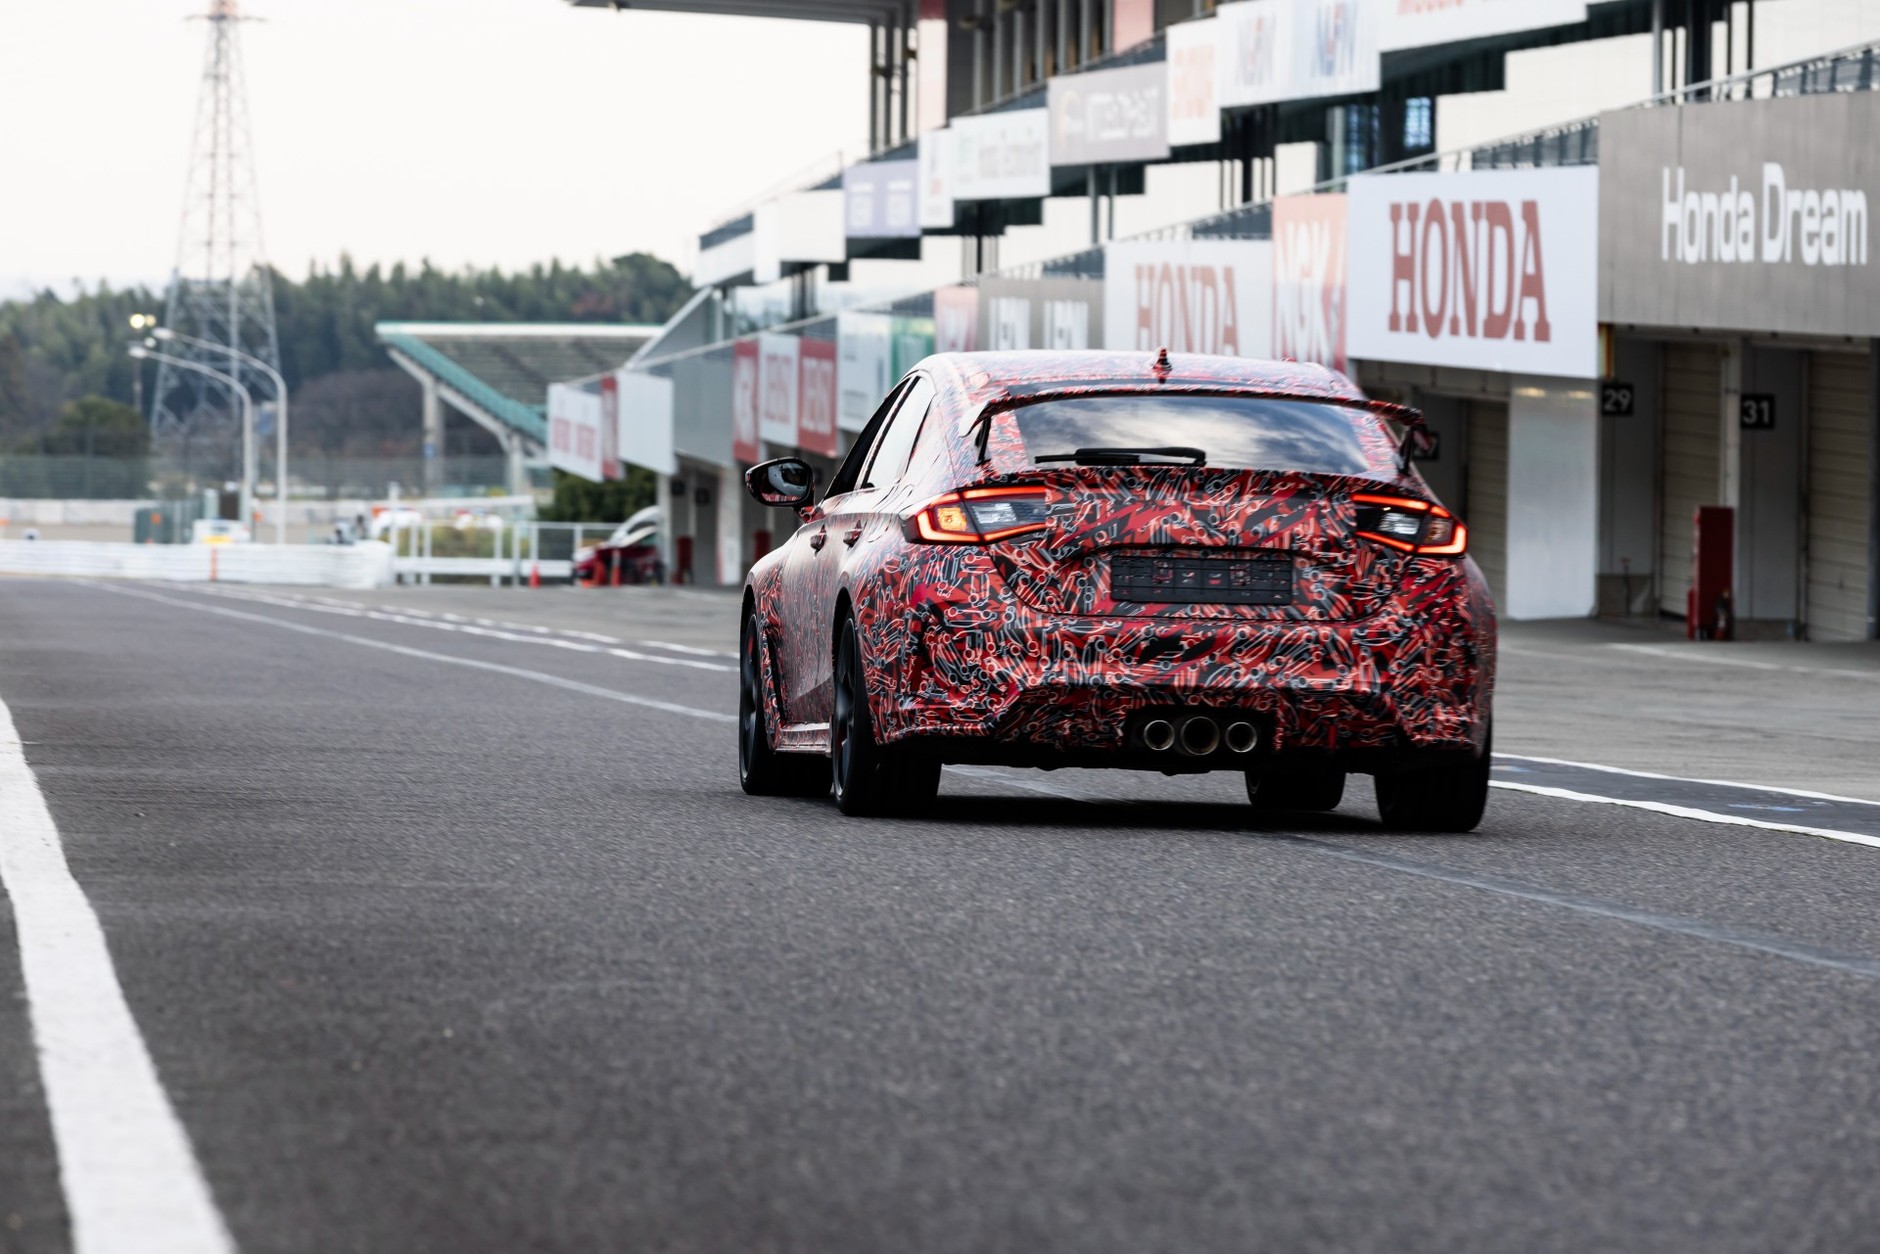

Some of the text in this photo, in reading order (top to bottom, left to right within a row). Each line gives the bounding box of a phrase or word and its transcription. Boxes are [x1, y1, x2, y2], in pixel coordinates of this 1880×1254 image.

[1661, 162, 1869, 266] Honda Dream
[1135, 263, 1240, 357] HONDA
[1275, 220, 1331, 366] NGK
[1388, 198, 1552, 342] HONDA
[1603, 388, 1631, 412] 29
[1743, 400, 1770, 425] 31
